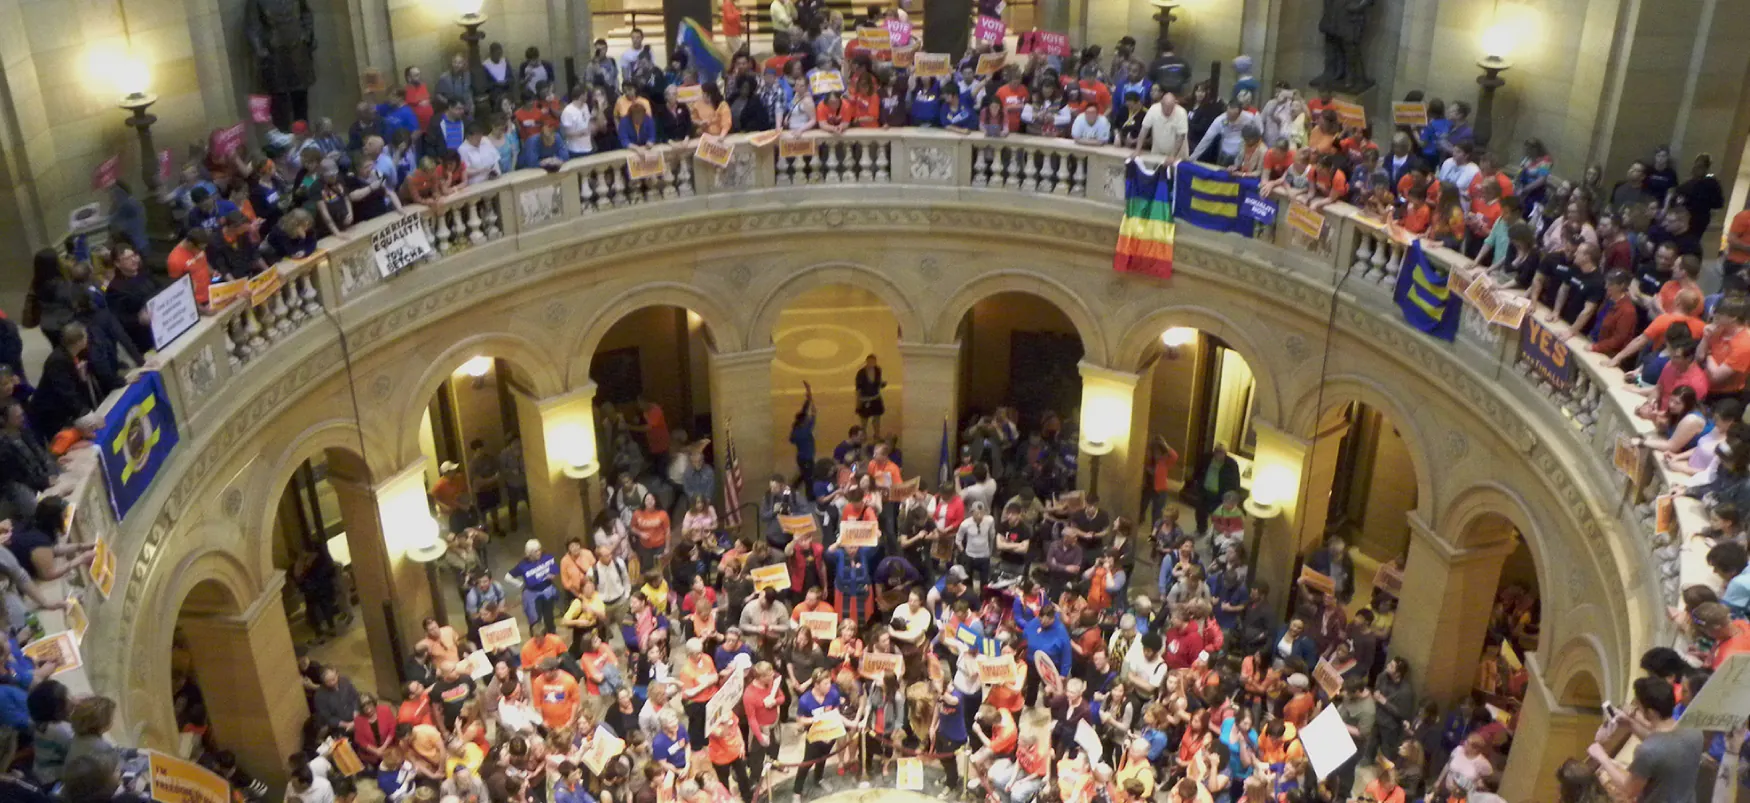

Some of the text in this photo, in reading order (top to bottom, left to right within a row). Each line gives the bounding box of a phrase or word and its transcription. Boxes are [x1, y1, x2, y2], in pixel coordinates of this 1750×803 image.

[887, 19, 909, 33] VOTE
[982, 18, 1003, 33] VOTE
[983, 31, 997, 41] NO
[1041, 33, 1065, 43] VOTE
[1047, 45, 1061, 54] NO
[1244, 198, 1275, 214] EQUALITY
[1251, 206, 1267, 217] NOW
[373, 212, 418, 242] MARRIAGE
[374, 220, 420, 252] EQUALITY
[385, 247, 403, 262] YOU
[387, 246, 424, 272] BETCHA
[1529, 318, 1568, 368] YES
